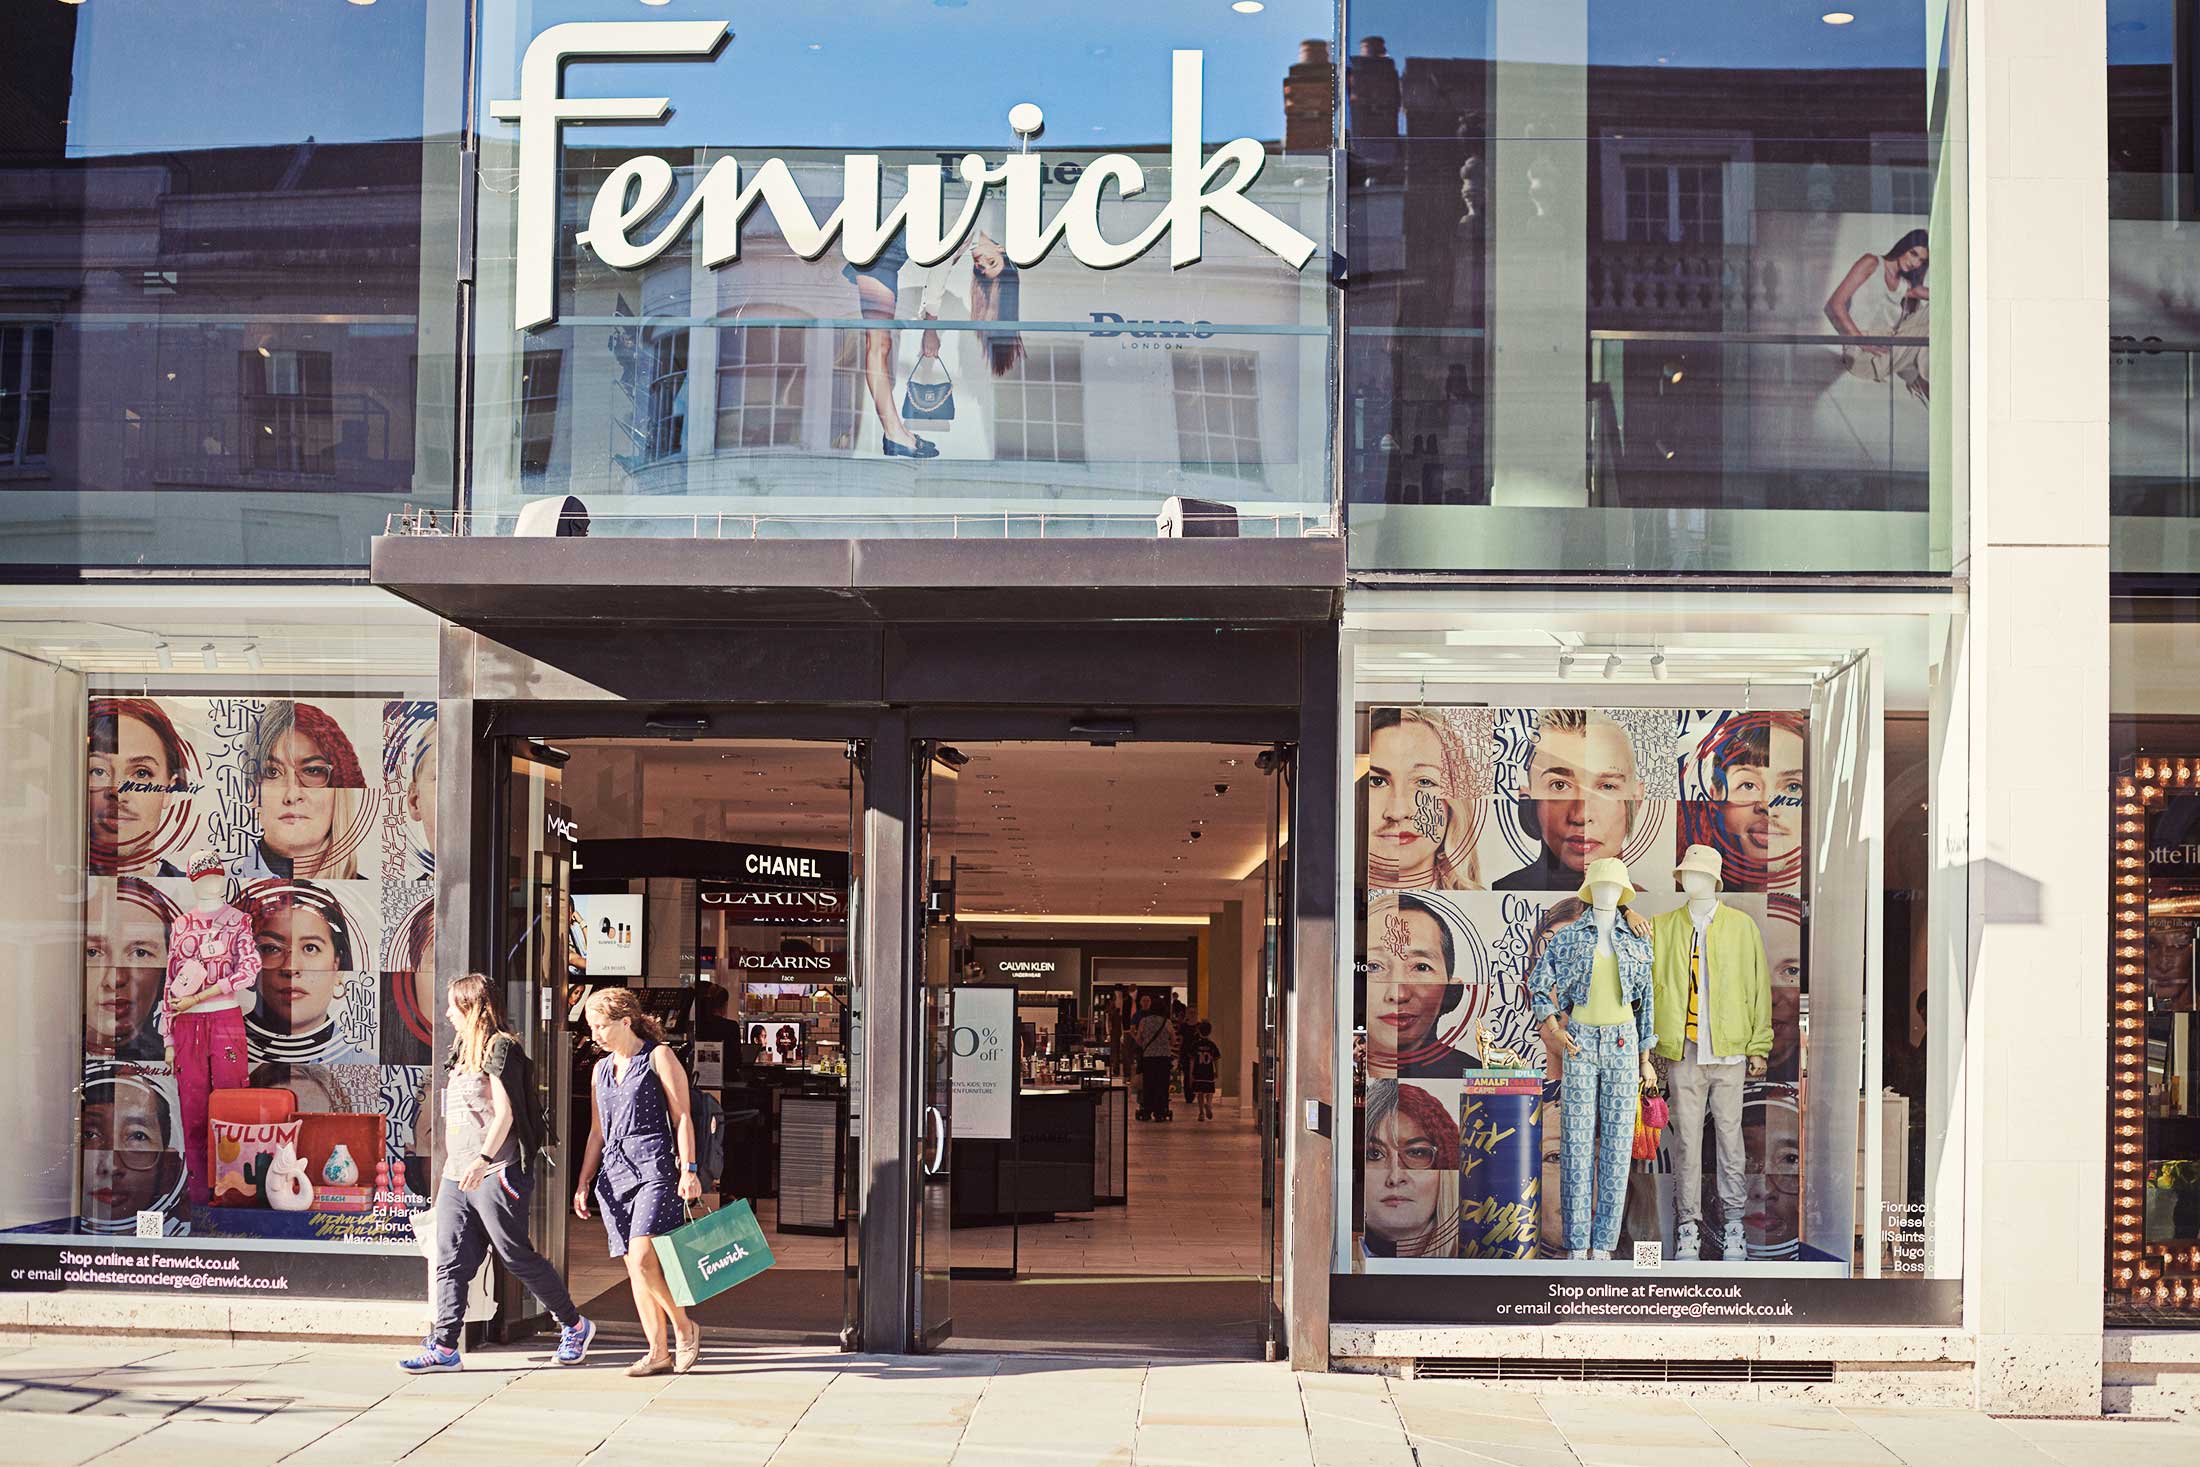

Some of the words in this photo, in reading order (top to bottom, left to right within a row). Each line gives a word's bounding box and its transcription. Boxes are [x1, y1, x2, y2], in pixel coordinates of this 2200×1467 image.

[489, 21, 1317, 330] Fenwick
[1122, 342, 1183, 350] LONDON
[1415, 790, 1444, 811] COME
[745, 853, 821, 878] CHANEL
[999, 961, 1030, 972] CALVIN
[1031, 962, 1055, 972] KLEIN
[1474, 1078, 1510, 1086] AMALFI
[214, 1123, 298, 1144] TULUM
[373, 1192, 424, 1204] AllSaints
[373, 1206, 387, 1217] Ed
[375, 1220, 413, 1232] Fioruc
[1888, 1216, 1925, 1228] Diesel
[343, 1234, 373, 1246] Marc
[1881, 1231, 1926, 1243] llSaints
[1893, 1246, 1925, 1260] Hugo
[59, 1251, 92, 1267] Shop
[94, 1252, 135, 1268] online
[136, 1255, 150, 1268] at
[152, 1254, 240, 1271] Fenwick.co.uk
[697, 1242, 750, 1281] Fenwick
[1894, 1260, 1925, 1272] Boss
[11, 1269, 25, 1280] or
[27, 1268, 62, 1282] email
[64, 1269, 289, 1290] colchesterconcierge@fenwick.co.uk
[1548, 1284, 1584, 1299] Shop
[1586, 1284, 1629, 1298] online
[1631, 1286, 1646, 1298] at
[1648, 1284, 1742, 1299] Fenwick.co.uk
[1496, 1303, 1512, 1315] or
[1514, 1302, 1551, 1315] email
[1554, 1302, 1793, 1318] colchesterconcierge@fenwick.co.uk
